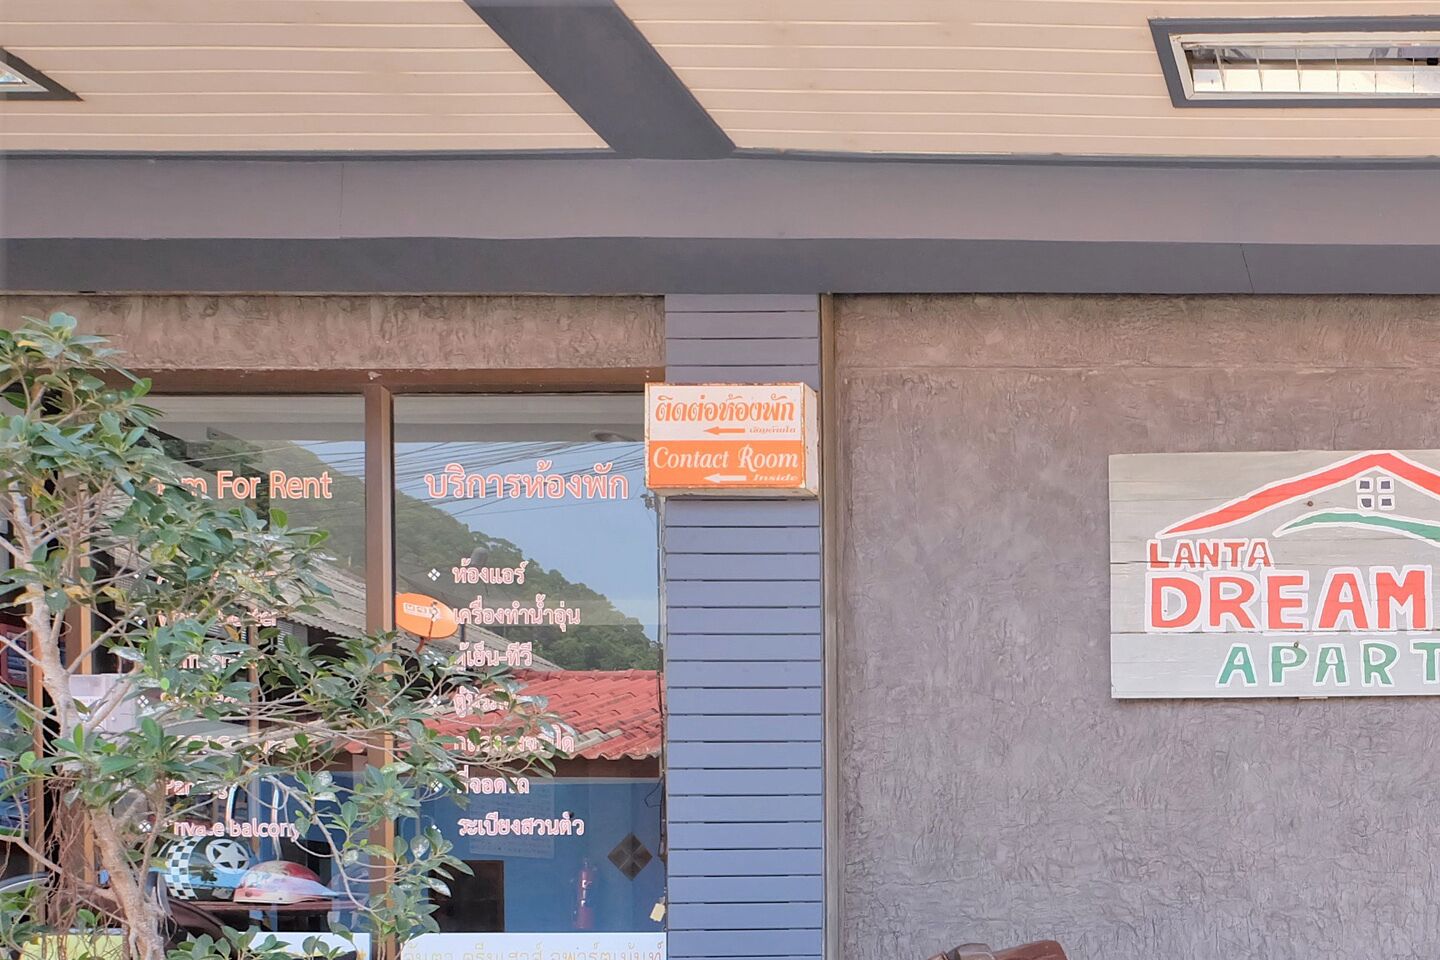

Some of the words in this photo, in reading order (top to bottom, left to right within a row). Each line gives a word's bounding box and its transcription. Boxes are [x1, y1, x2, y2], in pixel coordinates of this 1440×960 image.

[655, 392, 796, 422] ติดต่อห้องพัก
[652, 445, 730, 470] Contact
[738, 443, 799, 473] Room
[217, 470, 261, 500] For
[269, 470, 332, 499] Rent
[424, 459, 630, 500] บริการห้องพัก
[753, 473, 799, 482] Inside
[1147, 538, 1273, 570] LANTA
[451, 557, 529, 585] ห้องแอร์
[1146, 569, 1430, 632] DREAM
